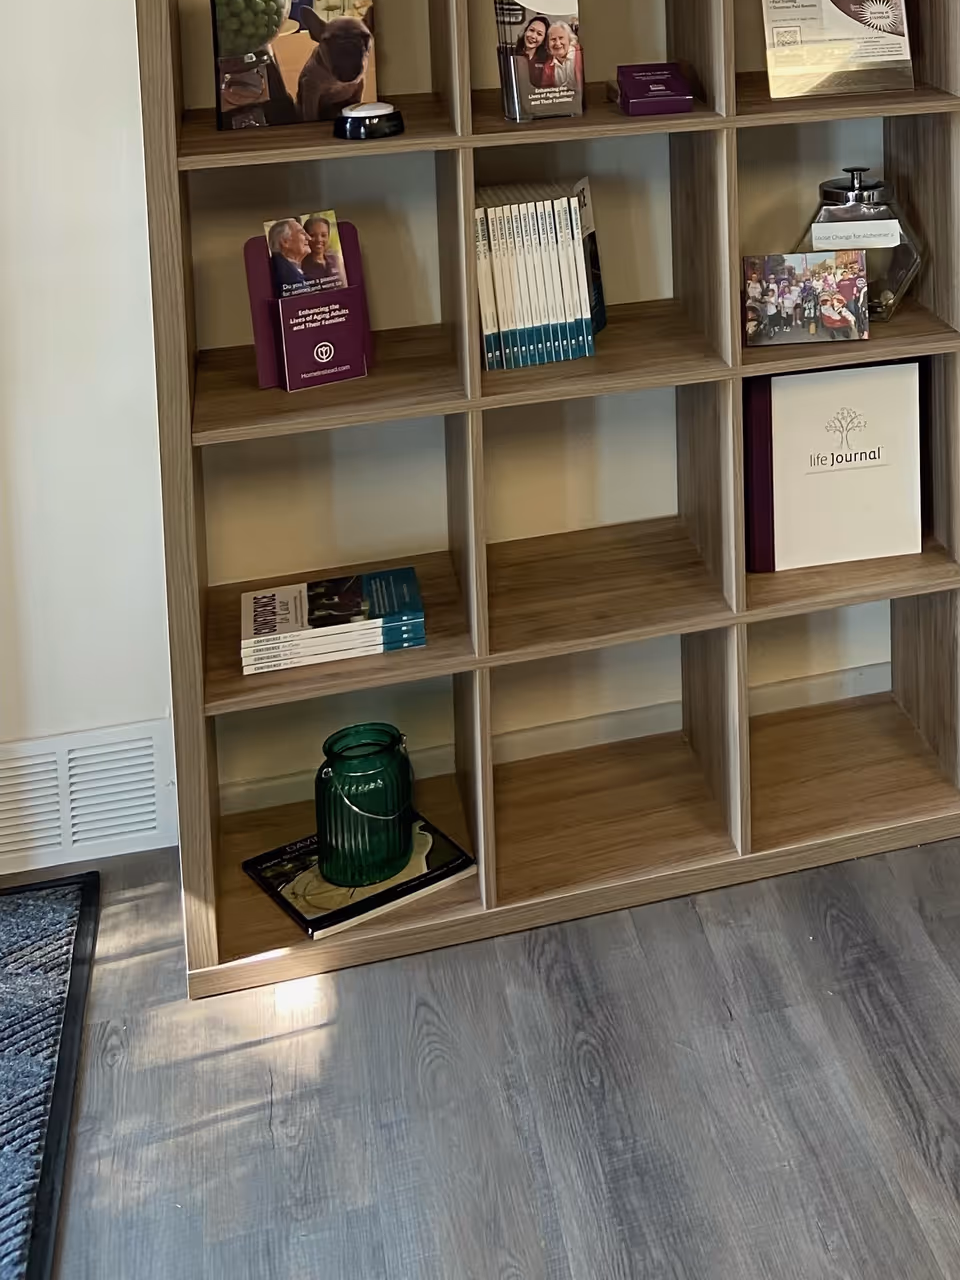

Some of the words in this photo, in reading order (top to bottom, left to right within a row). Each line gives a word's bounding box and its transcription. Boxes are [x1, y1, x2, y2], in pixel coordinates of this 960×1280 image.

[289, 317, 306, 325] Lives
[312, 312, 330, 321] Aging
[330, 308, 349, 317] Adults
[299, 305, 330, 316] Enhancing
[293, 323, 305, 331] and
[809, 452, 828, 468] life
[830, 446, 881, 467] Journal
[252, 594, 278, 635] CONFIDENCE
